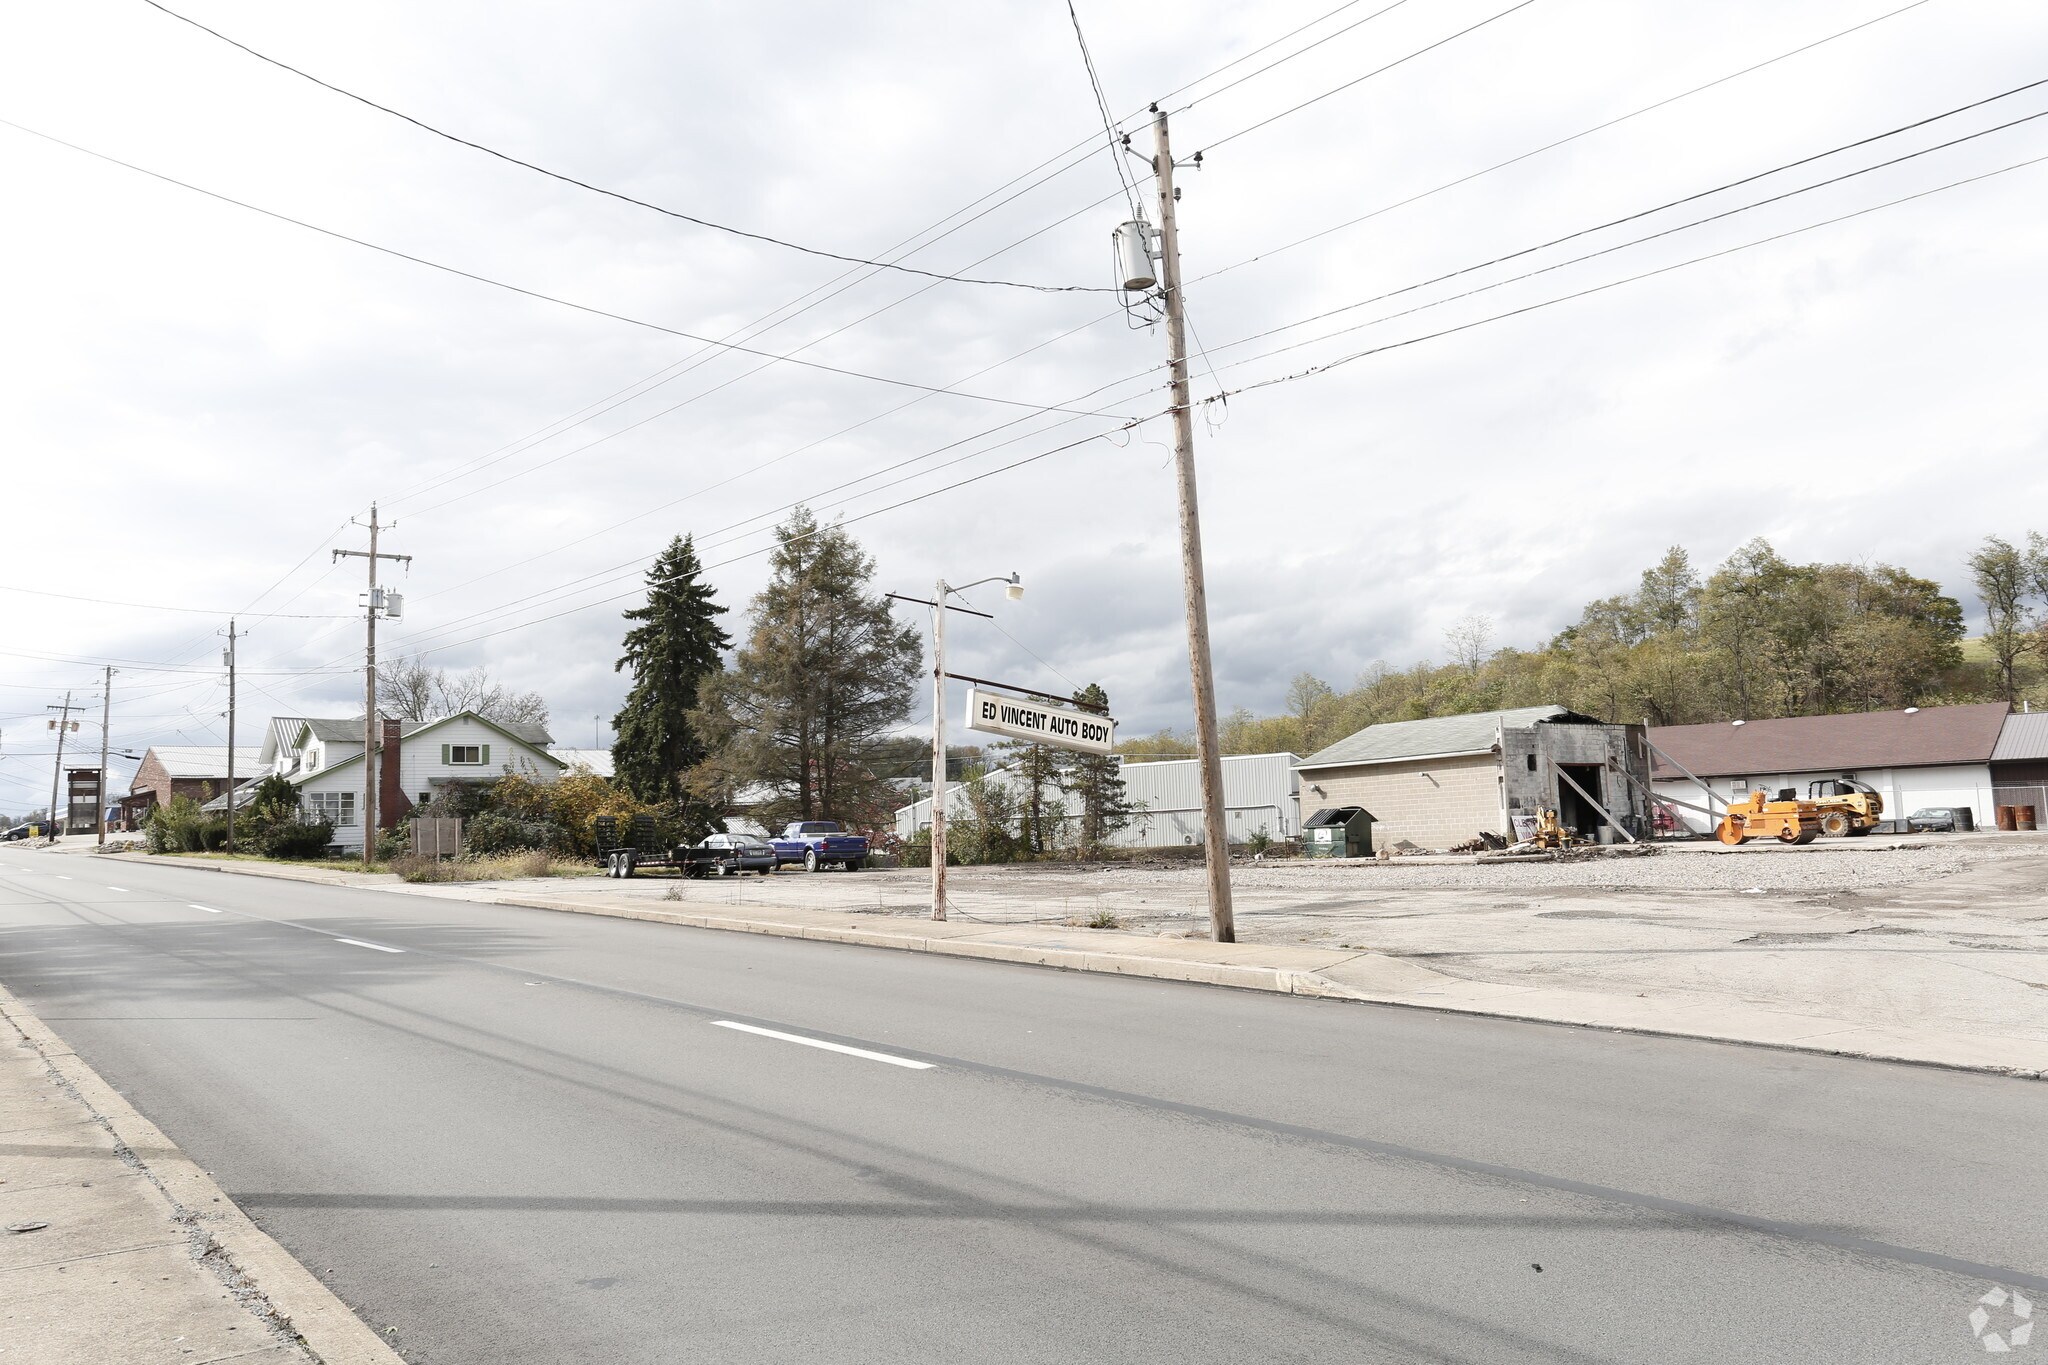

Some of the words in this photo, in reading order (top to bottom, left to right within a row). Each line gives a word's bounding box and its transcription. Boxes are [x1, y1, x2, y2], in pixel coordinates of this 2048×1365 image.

[982, 702, 997, 720] ED
[1000, 705, 1047, 731] VINCENT
[1050, 716, 1078, 737] AUTO
[1081, 722, 1109, 743] BODY
